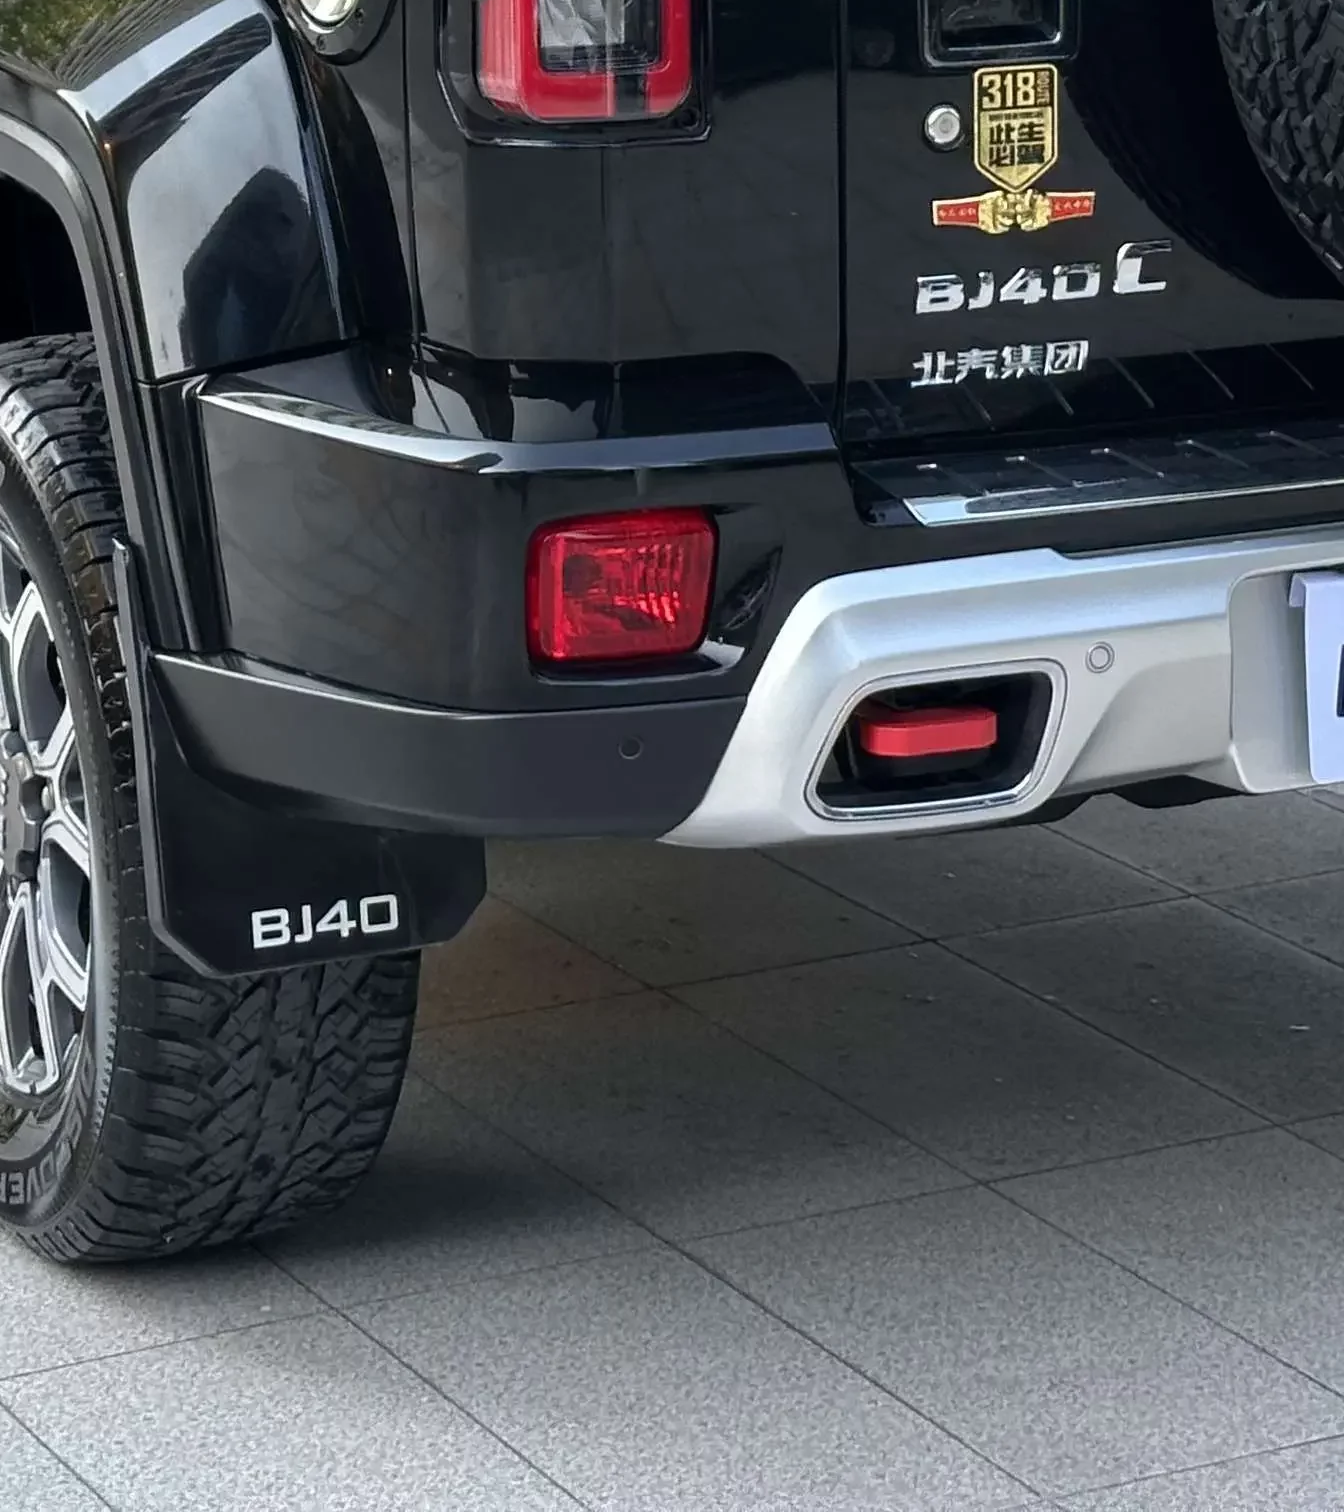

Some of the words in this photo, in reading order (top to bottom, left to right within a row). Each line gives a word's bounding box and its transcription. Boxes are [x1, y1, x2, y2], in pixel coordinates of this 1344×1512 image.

[981, 70, 1036, 109] 318
[988, 121, 1045, 144] 此生
[915, 262, 1102, 315] BJ40
[910, 340, 1089, 388] 北汽集团
[251, 894, 399, 950] BJ40
